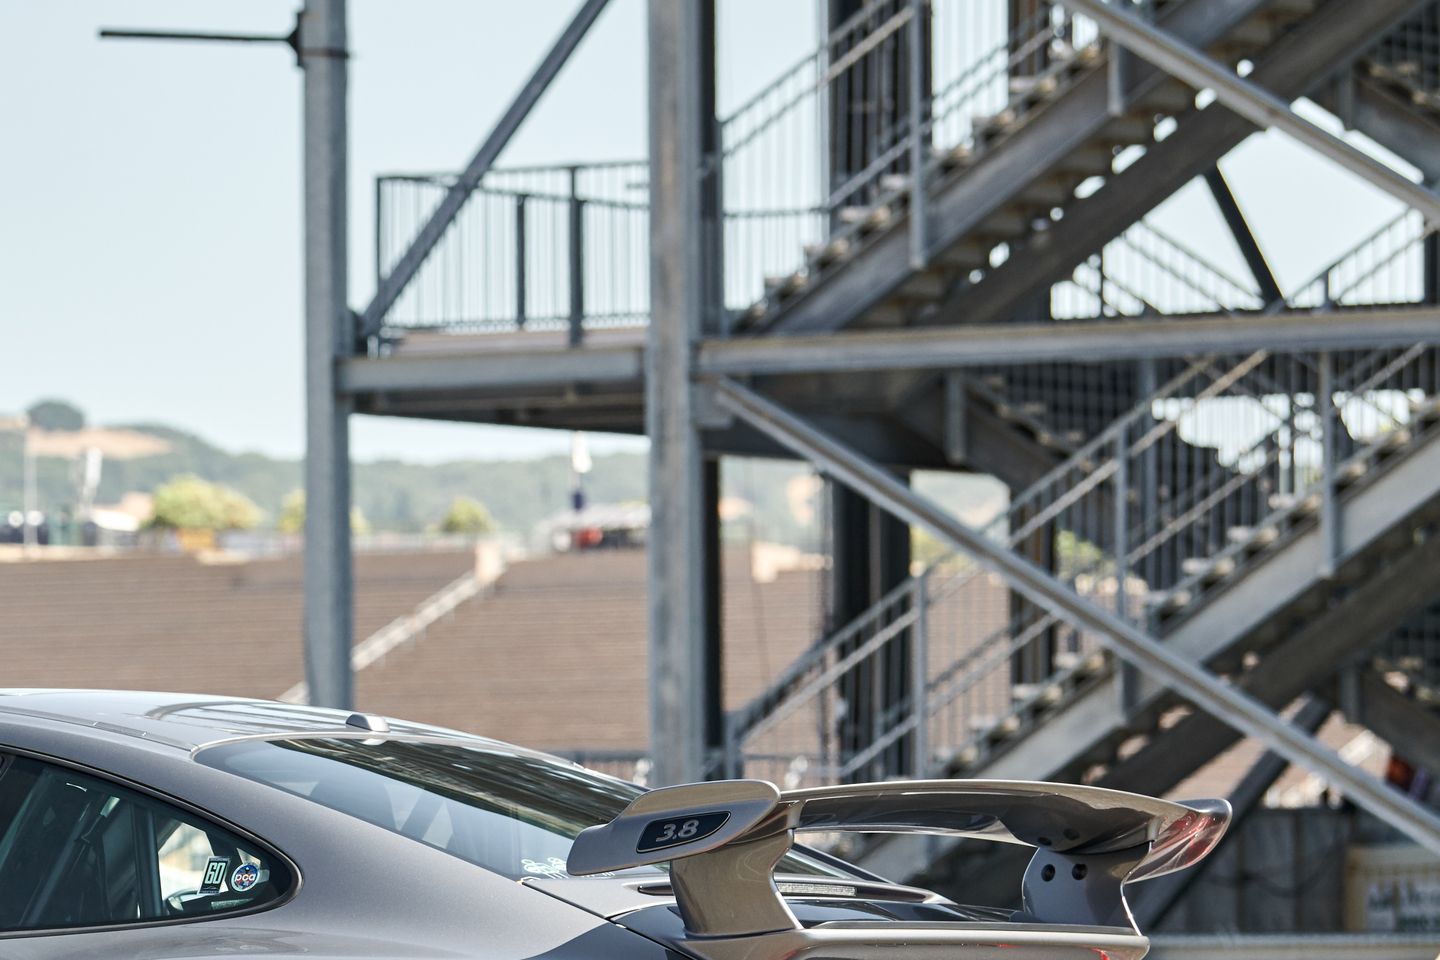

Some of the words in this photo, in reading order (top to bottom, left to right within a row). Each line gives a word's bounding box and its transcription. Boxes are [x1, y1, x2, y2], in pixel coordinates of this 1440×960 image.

[655, 819, 700, 842] 3.8
[204, 862, 226, 884] 60
[235, 873, 256, 882] pca
